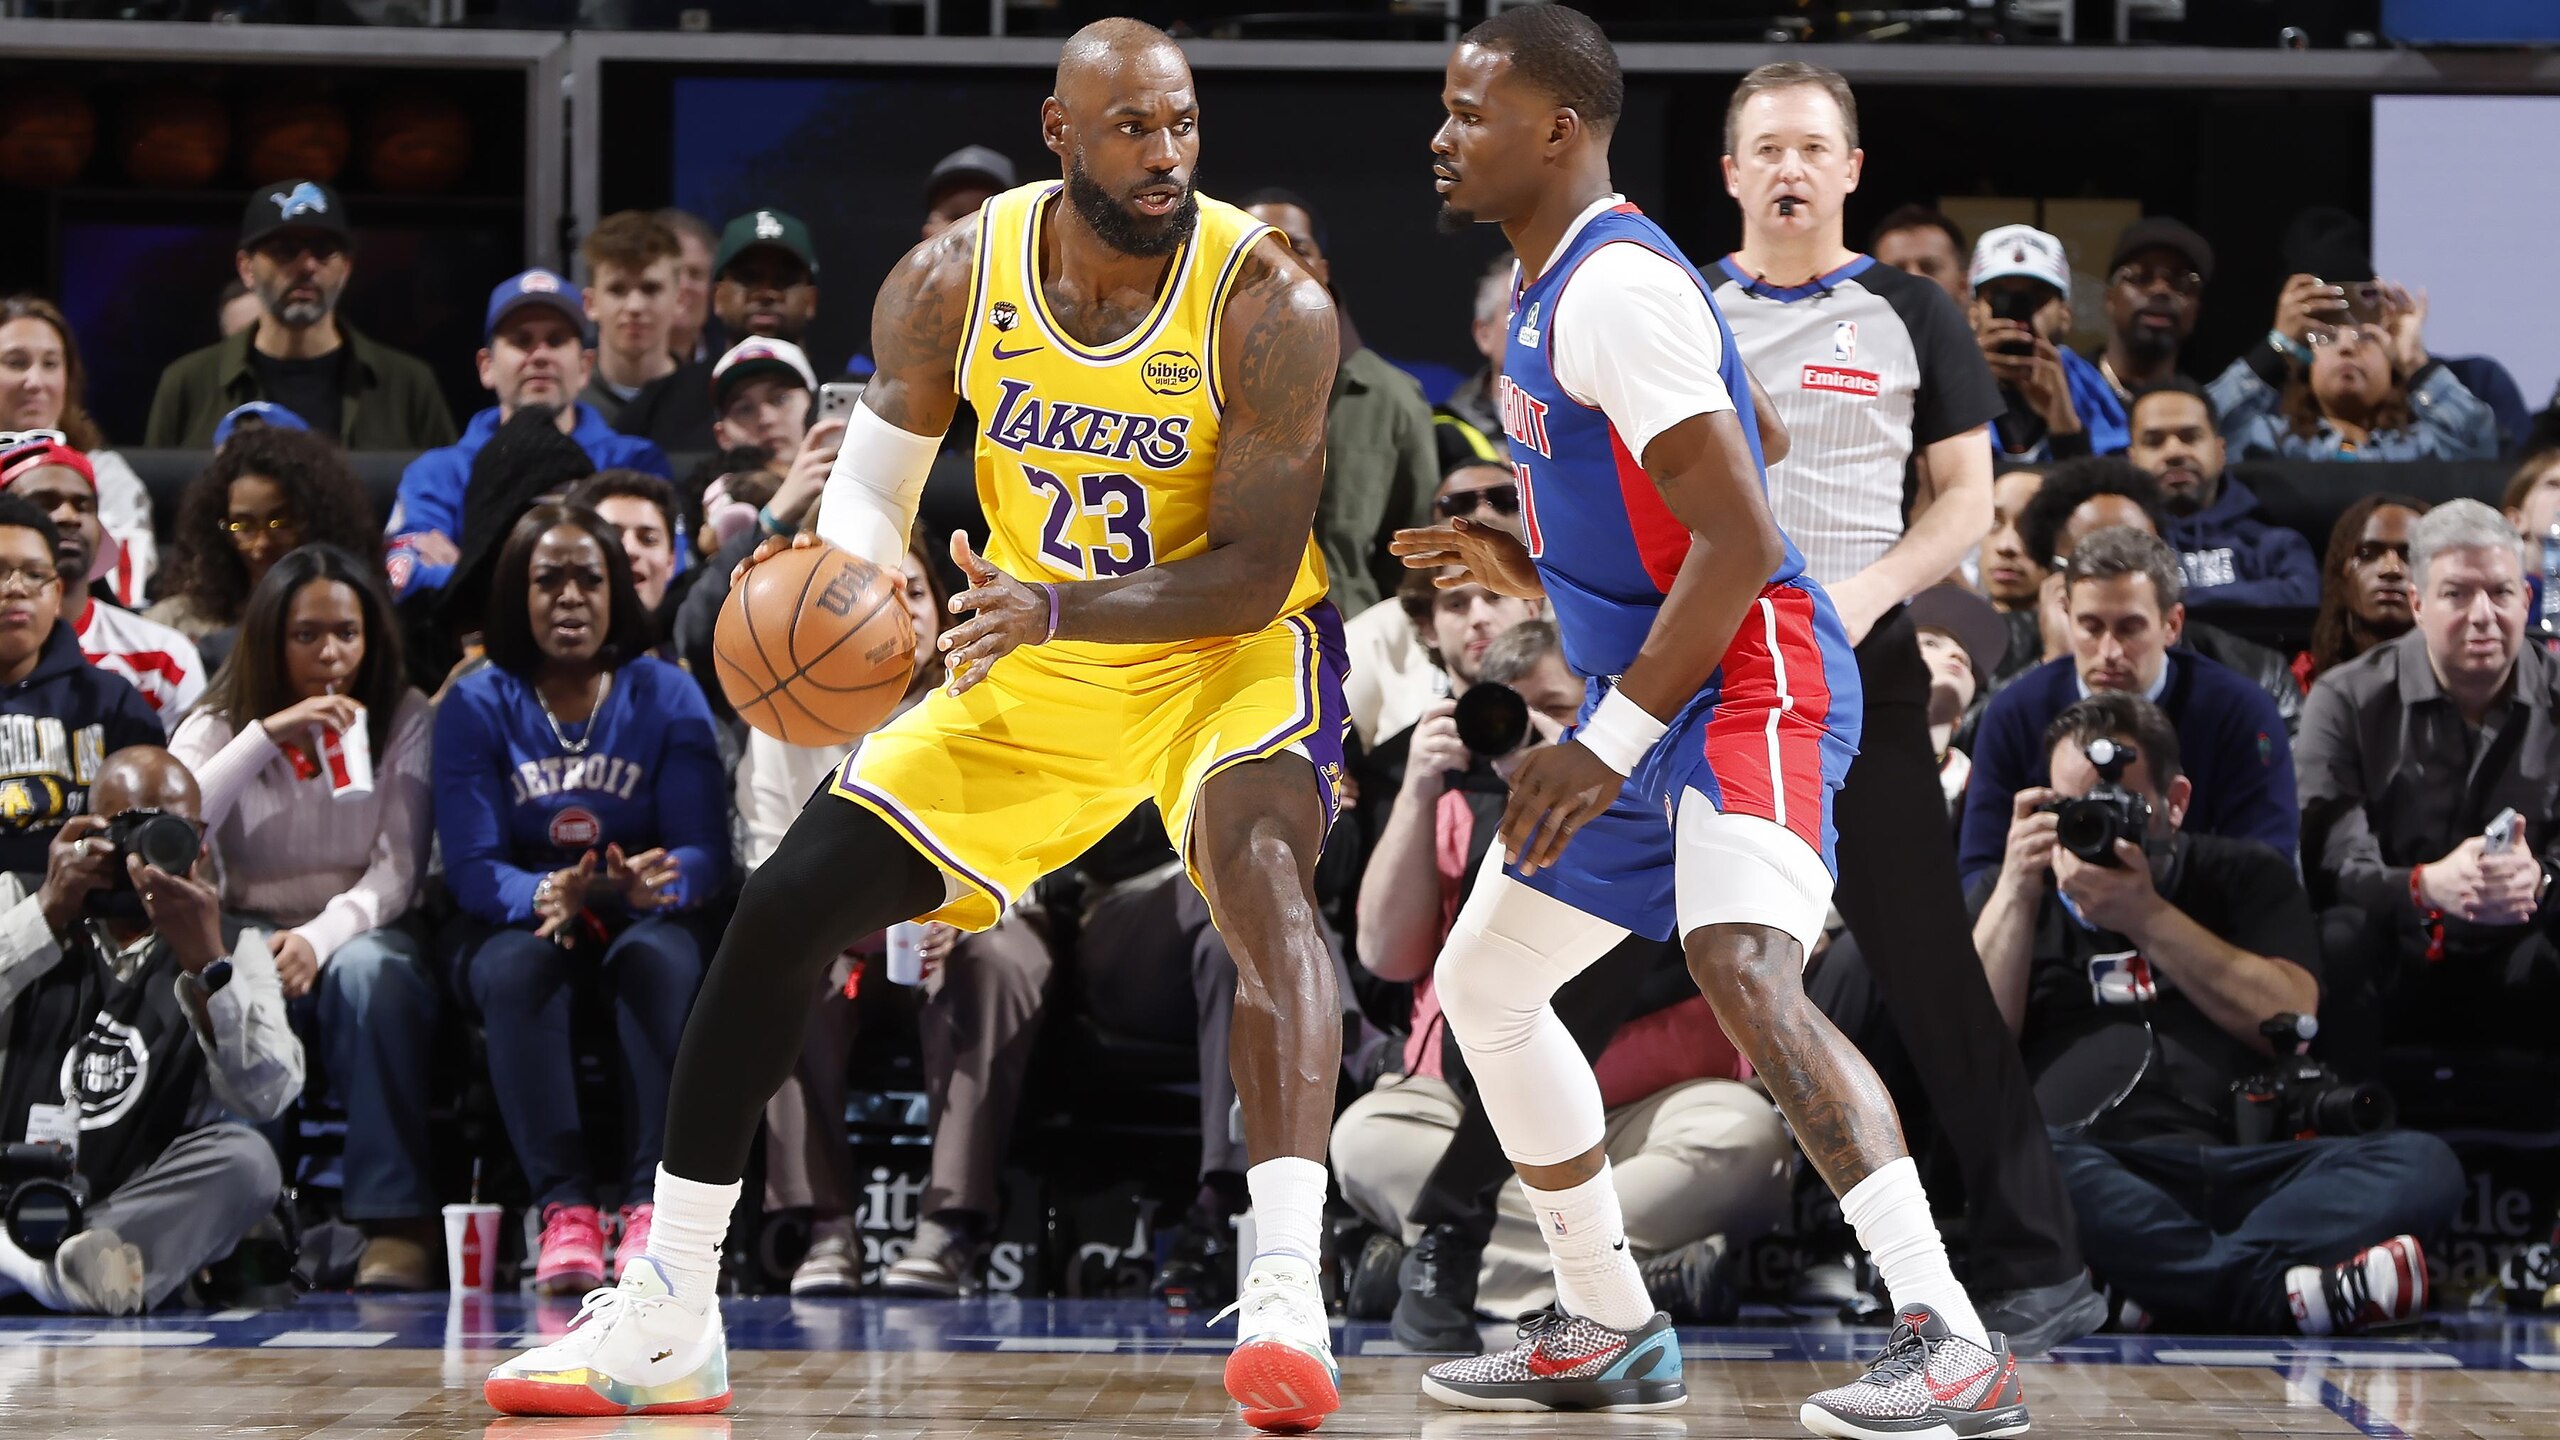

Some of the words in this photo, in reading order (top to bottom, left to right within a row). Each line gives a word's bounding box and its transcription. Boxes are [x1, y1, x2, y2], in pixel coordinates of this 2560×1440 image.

[1147, 363, 1199, 382] bibigo
[1155, 377, 1177, 386] 비비고
[1803, 369, 1880, 392] Emirates
[984, 376, 1192, 470] LAKERS
[1018, 462, 1155, 580] 23
